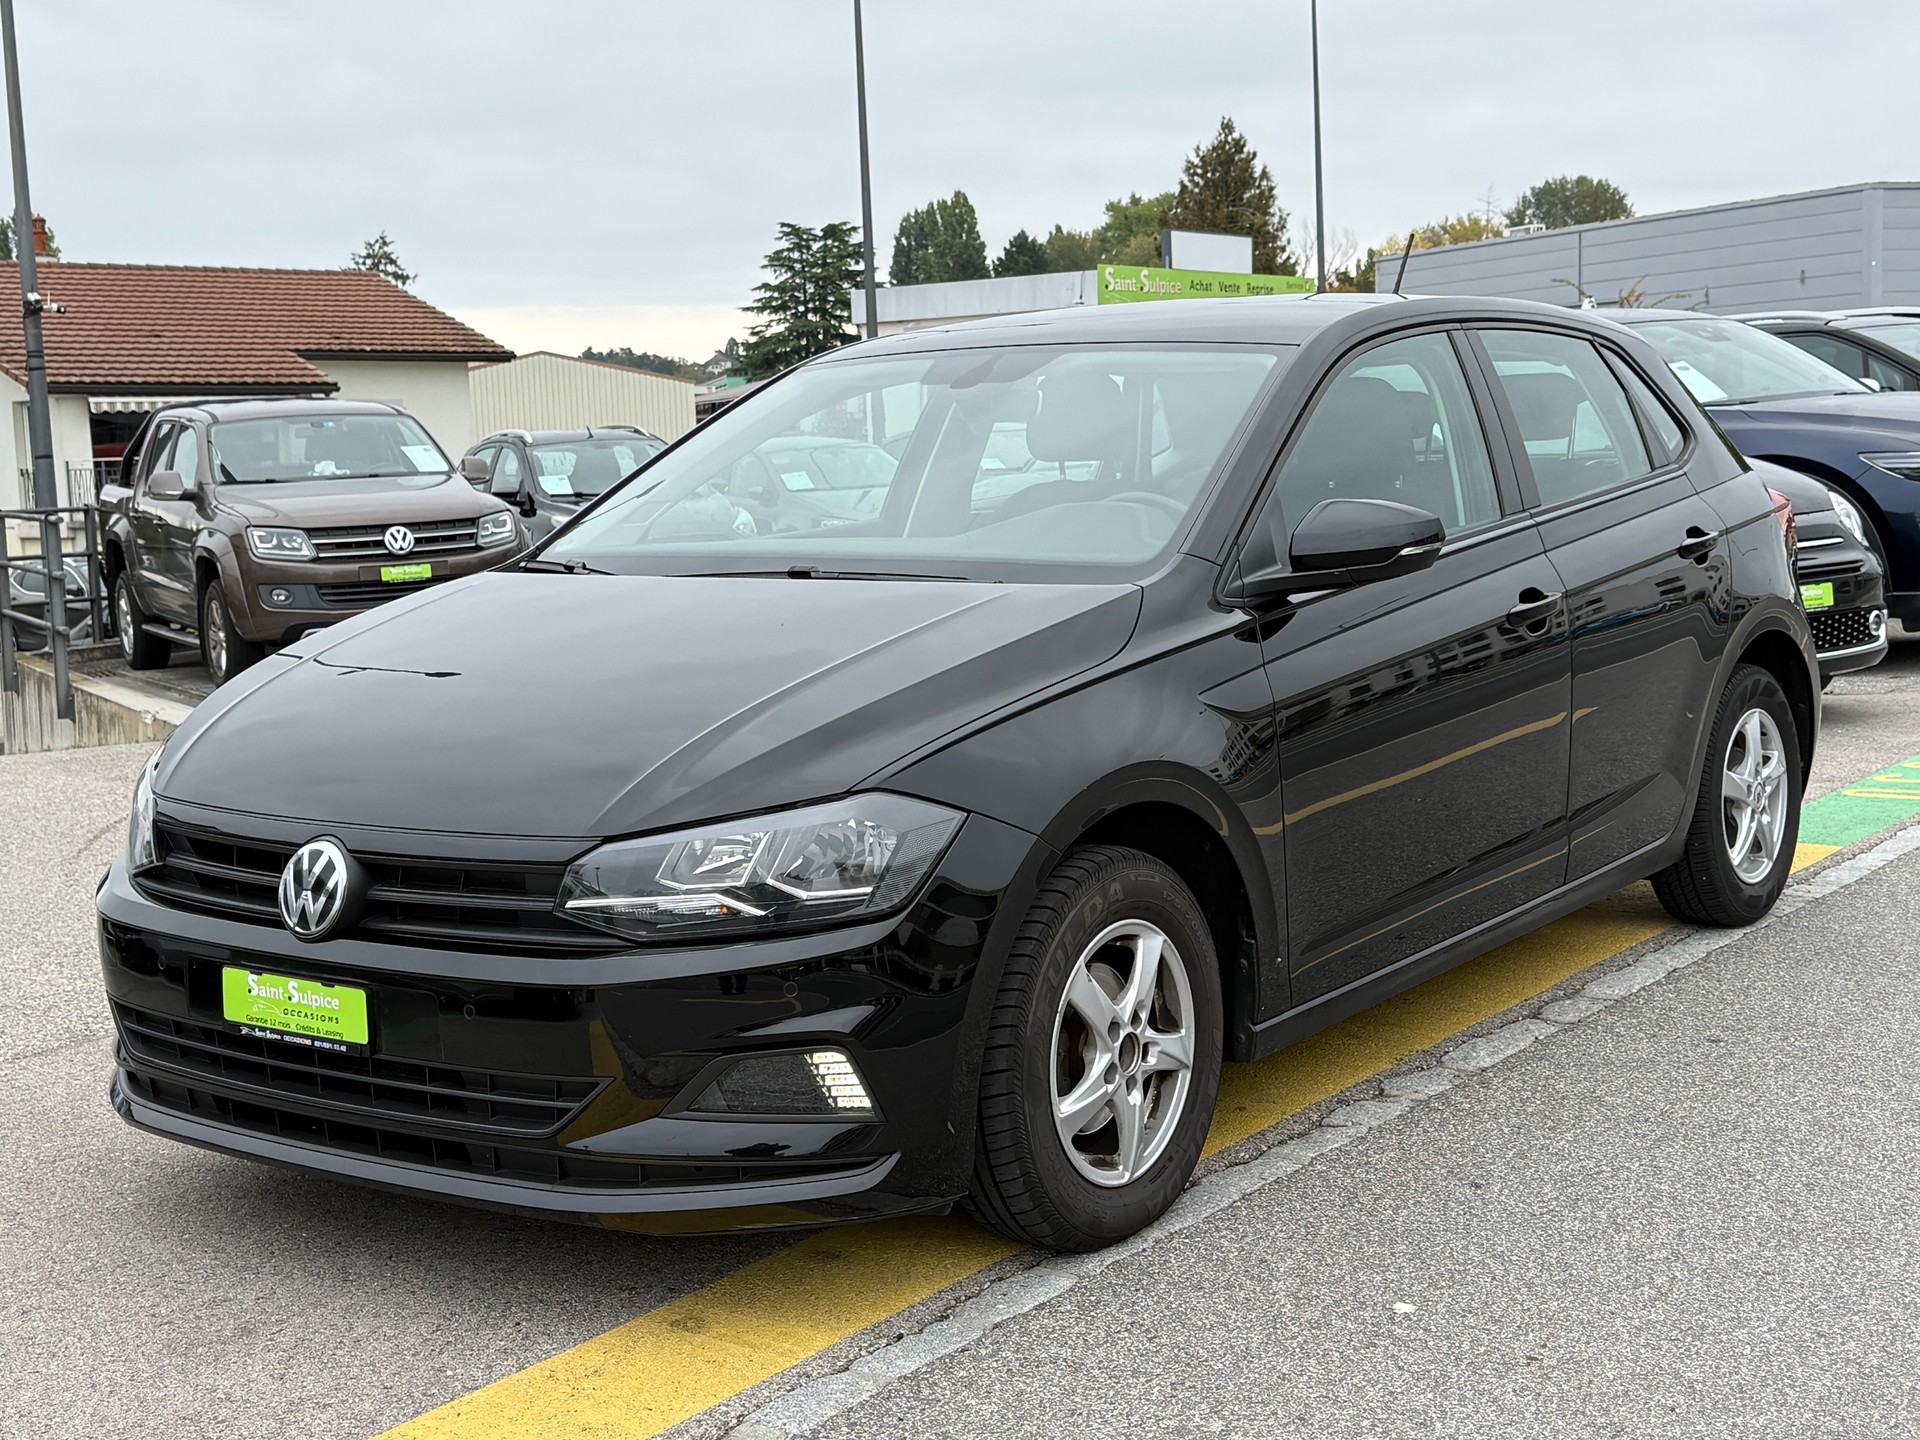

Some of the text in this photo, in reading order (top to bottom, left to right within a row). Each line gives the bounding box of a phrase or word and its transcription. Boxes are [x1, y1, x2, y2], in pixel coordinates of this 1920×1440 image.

[1189, 279, 1212, 292] Achat
[1218, 281, 1240, 293] Vente
[1247, 283, 1274, 295] Reprise
[280, 841, 347, 936] VW
[1036, 881, 1124, 1030] FULDA
[246, 1014, 344, 1039] Garantie 12 mois Crédits & Leasing
[283, 1008, 340, 1024] OCCASIONS
